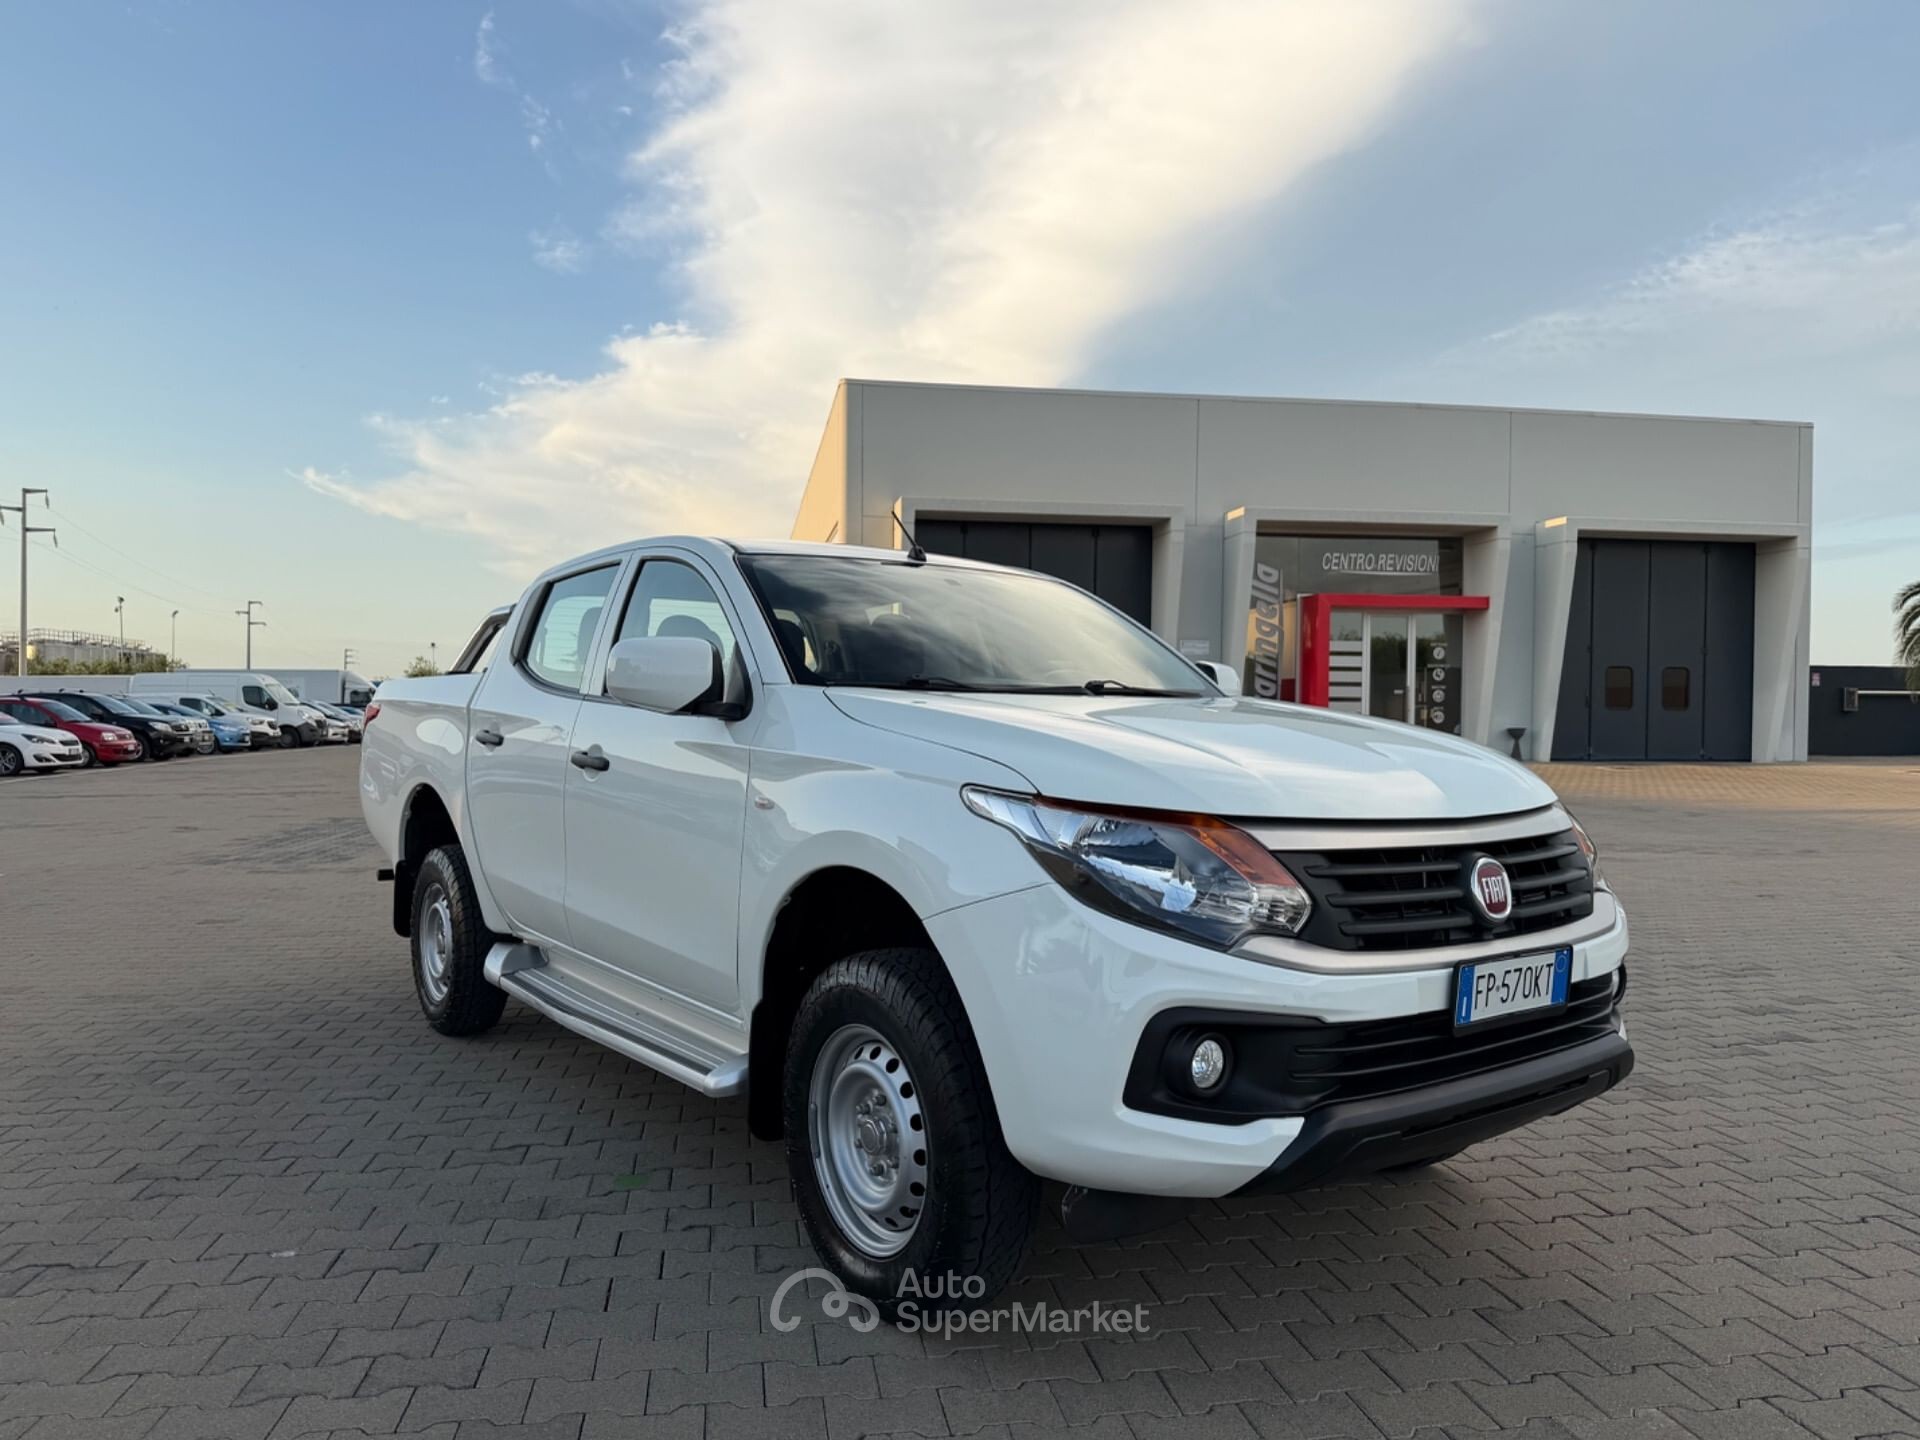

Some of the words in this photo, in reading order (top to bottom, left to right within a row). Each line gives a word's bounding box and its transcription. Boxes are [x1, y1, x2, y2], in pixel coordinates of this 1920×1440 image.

[1322, 552, 1375, 570] CENTRO
[1251, 562, 1284, 698] aringella
[1481, 876, 1505, 904] FIAT
